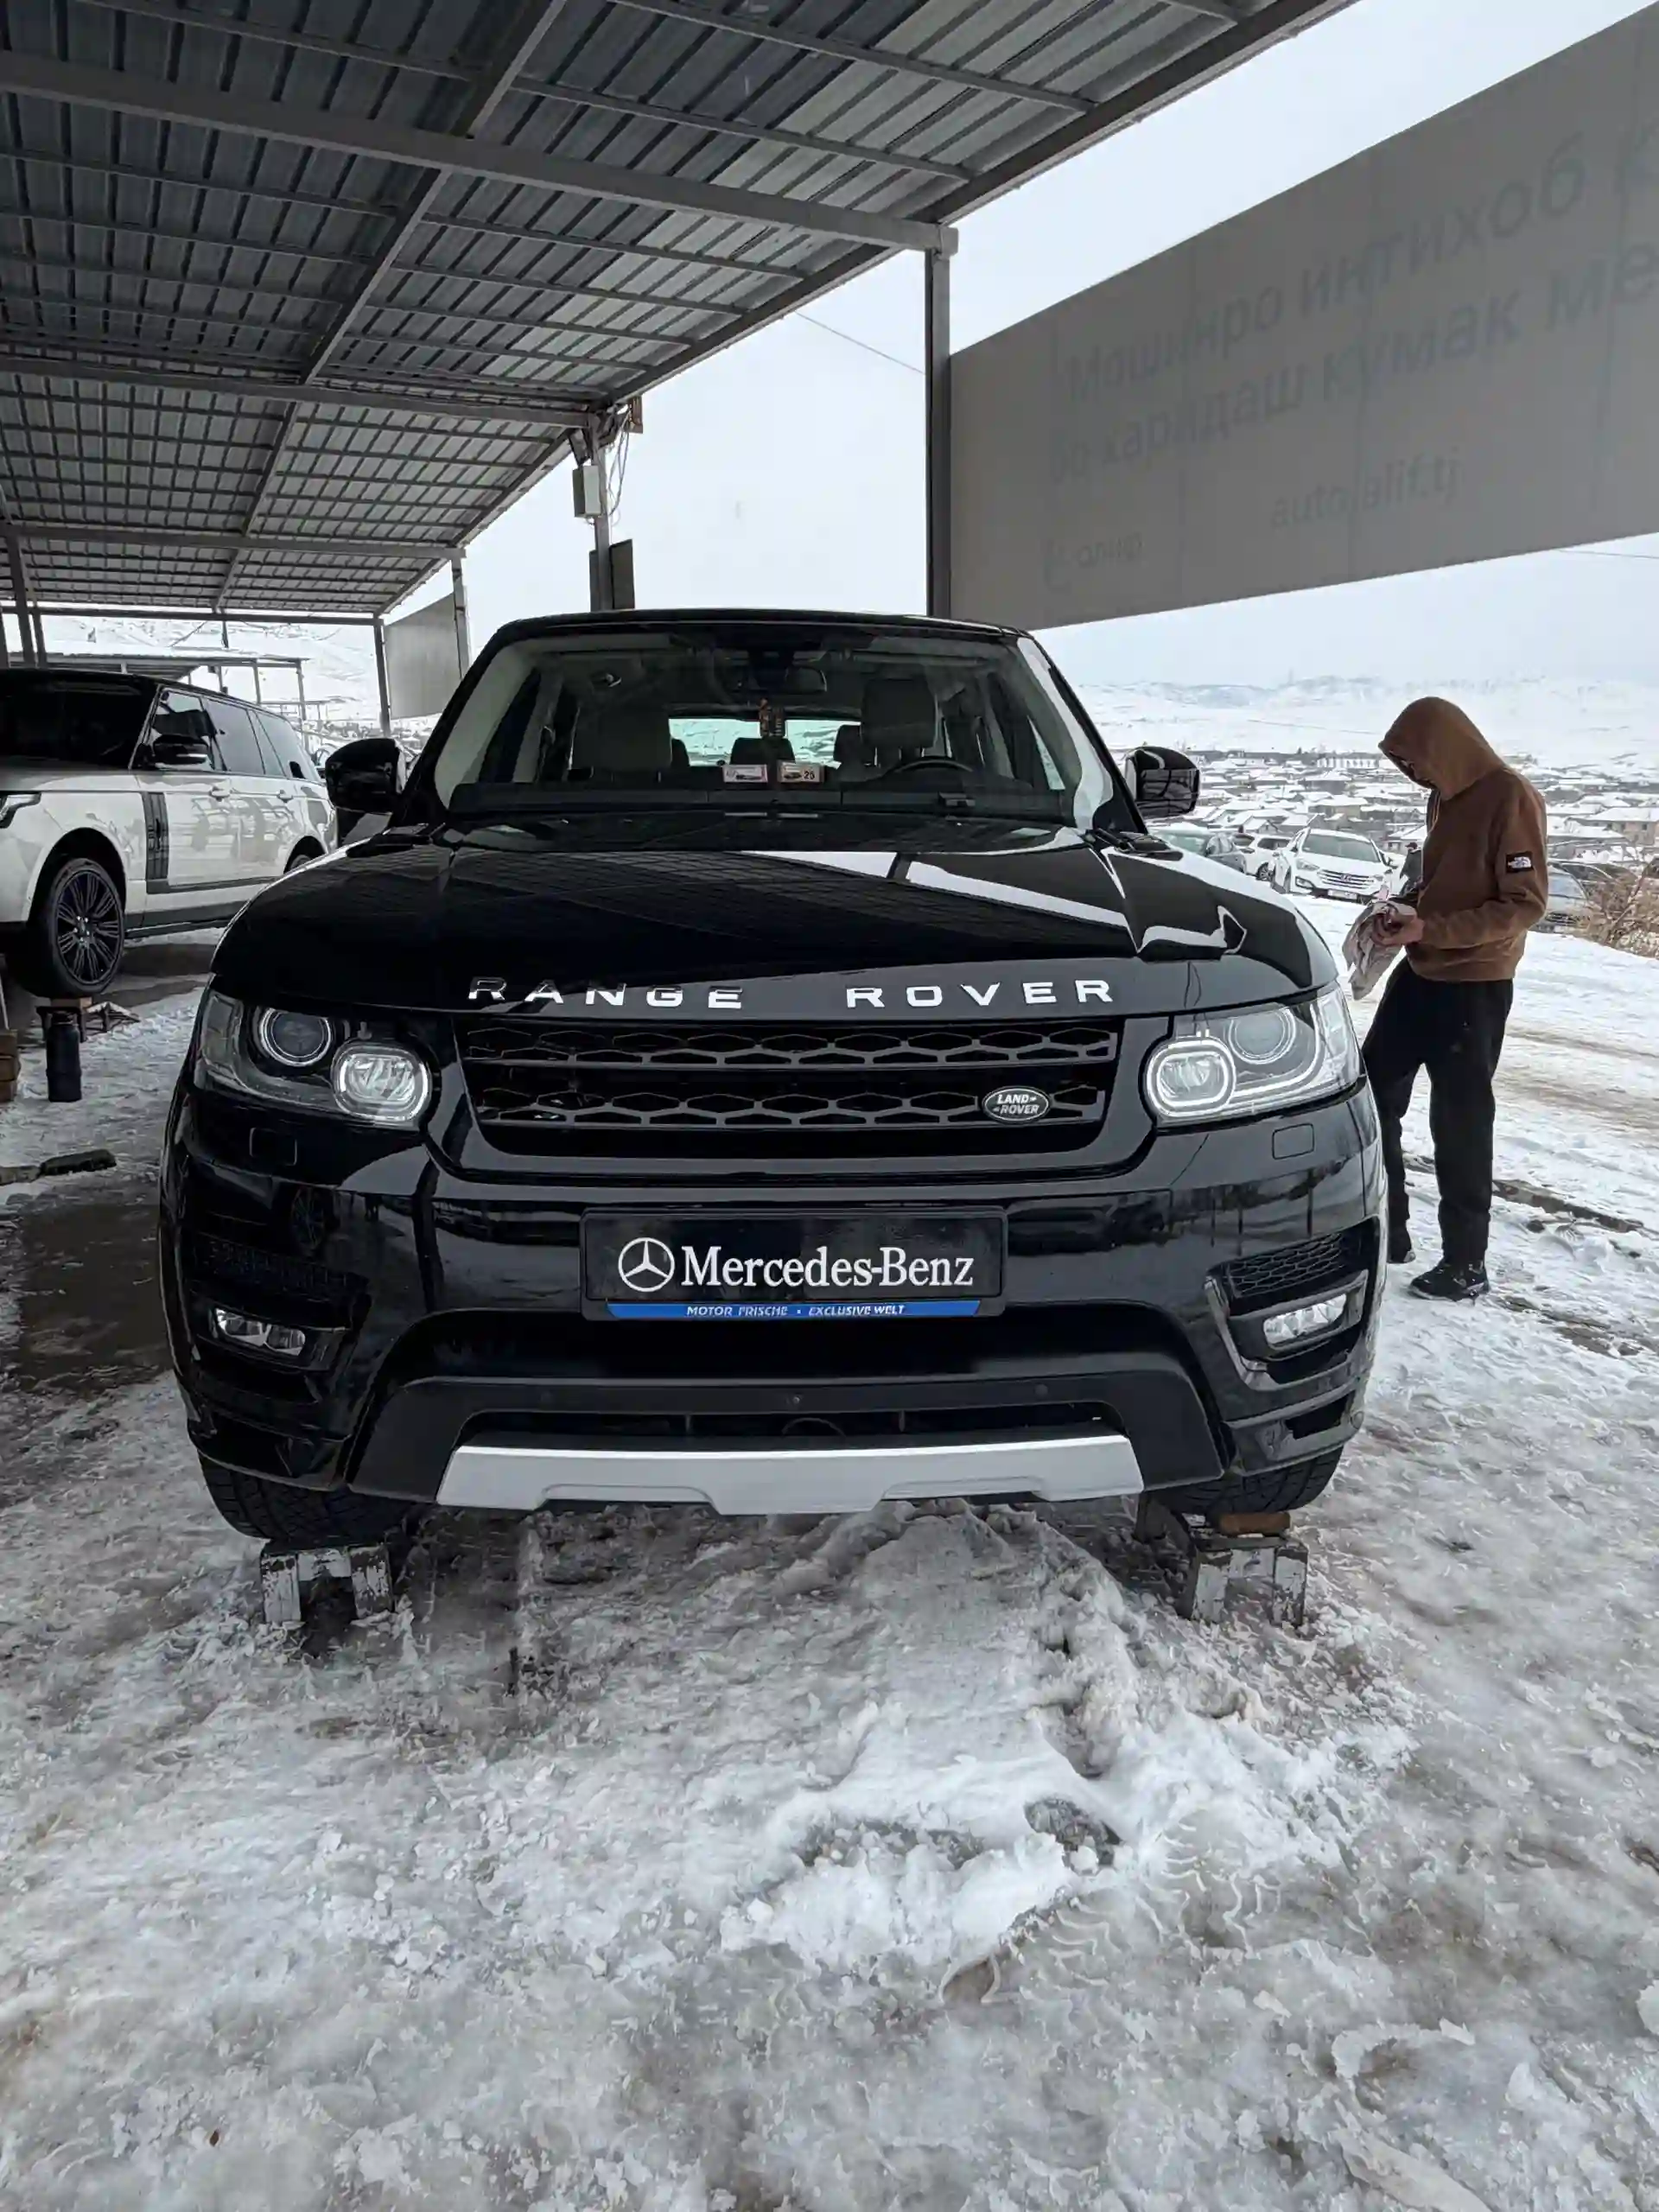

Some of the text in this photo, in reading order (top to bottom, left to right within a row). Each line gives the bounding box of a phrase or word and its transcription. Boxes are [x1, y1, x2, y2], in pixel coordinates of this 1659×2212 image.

[1300, 130, 1584, 319] интихоб
[467, 976, 1113, 1010] RANGE ROVER
[996, 1093, 1030, 1104] LAND
[999, 1104, 1040, 1115] ROVER
[681, 1245, 975, 1287] Mercedes-Benz
[686, 1306, 733, 1316] MOTOR
[808, 1306, 871, 1316] EXCLUSIVE
[873, 1304, 906, 1315] WELT
